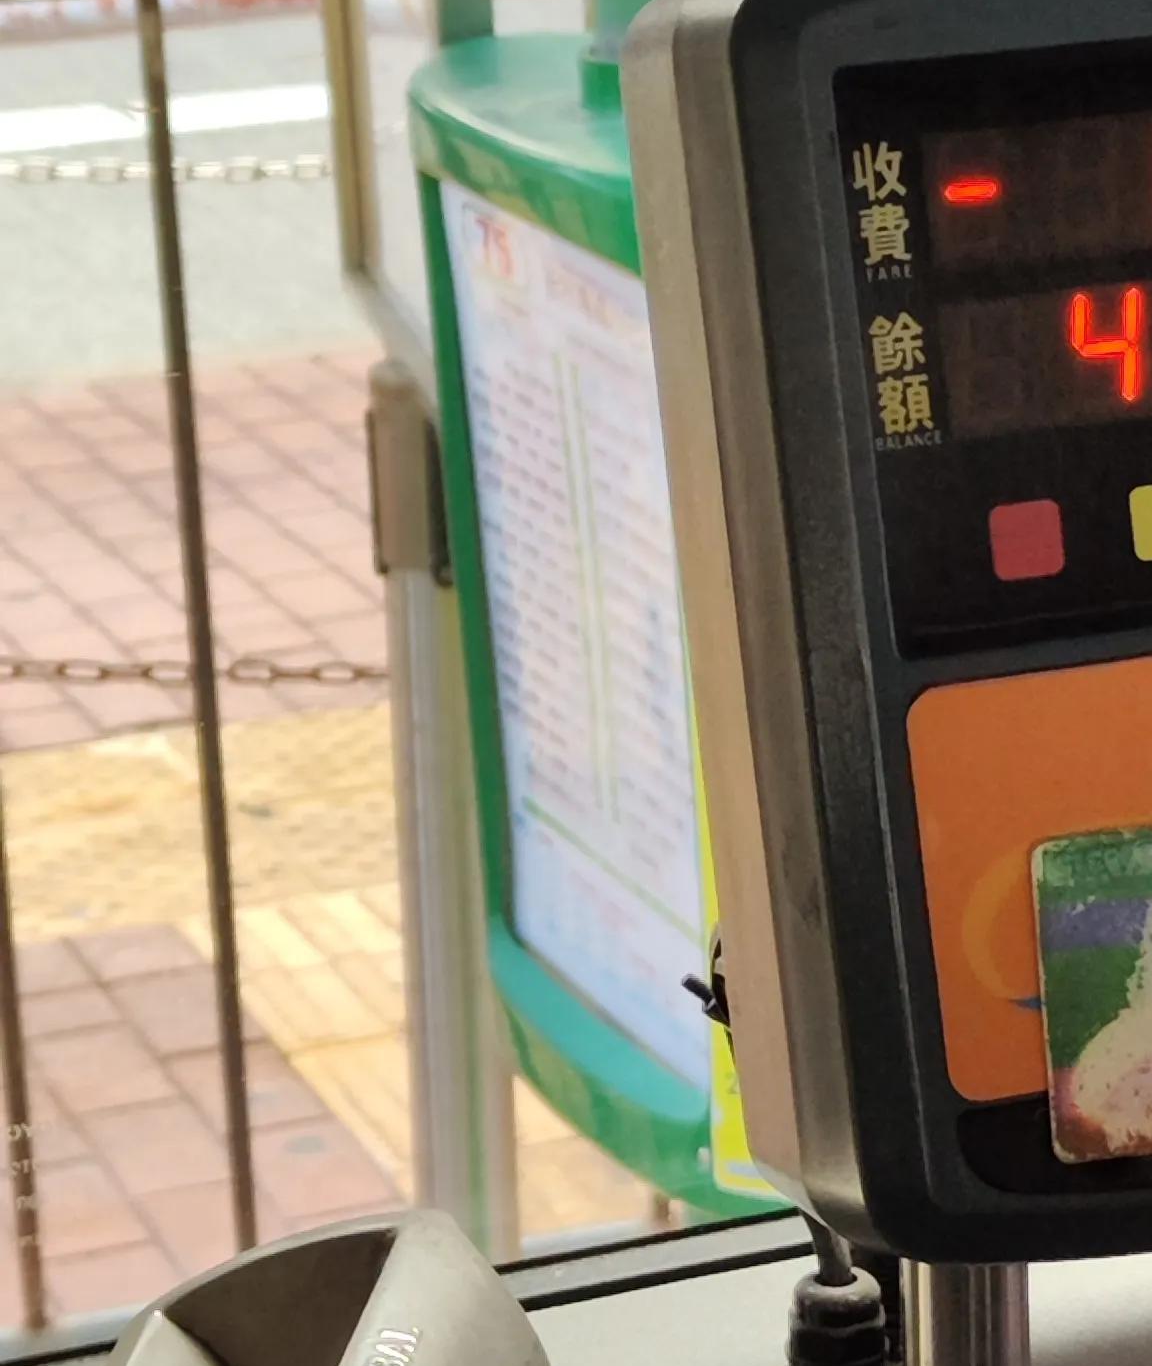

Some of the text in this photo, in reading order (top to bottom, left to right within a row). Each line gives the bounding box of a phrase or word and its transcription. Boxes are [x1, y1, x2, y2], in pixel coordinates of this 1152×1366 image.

[852, 141, 912, 265] 收費
[868, 311, 934, 434] 餘額
[875, 430, 943, 451] BALANCE
